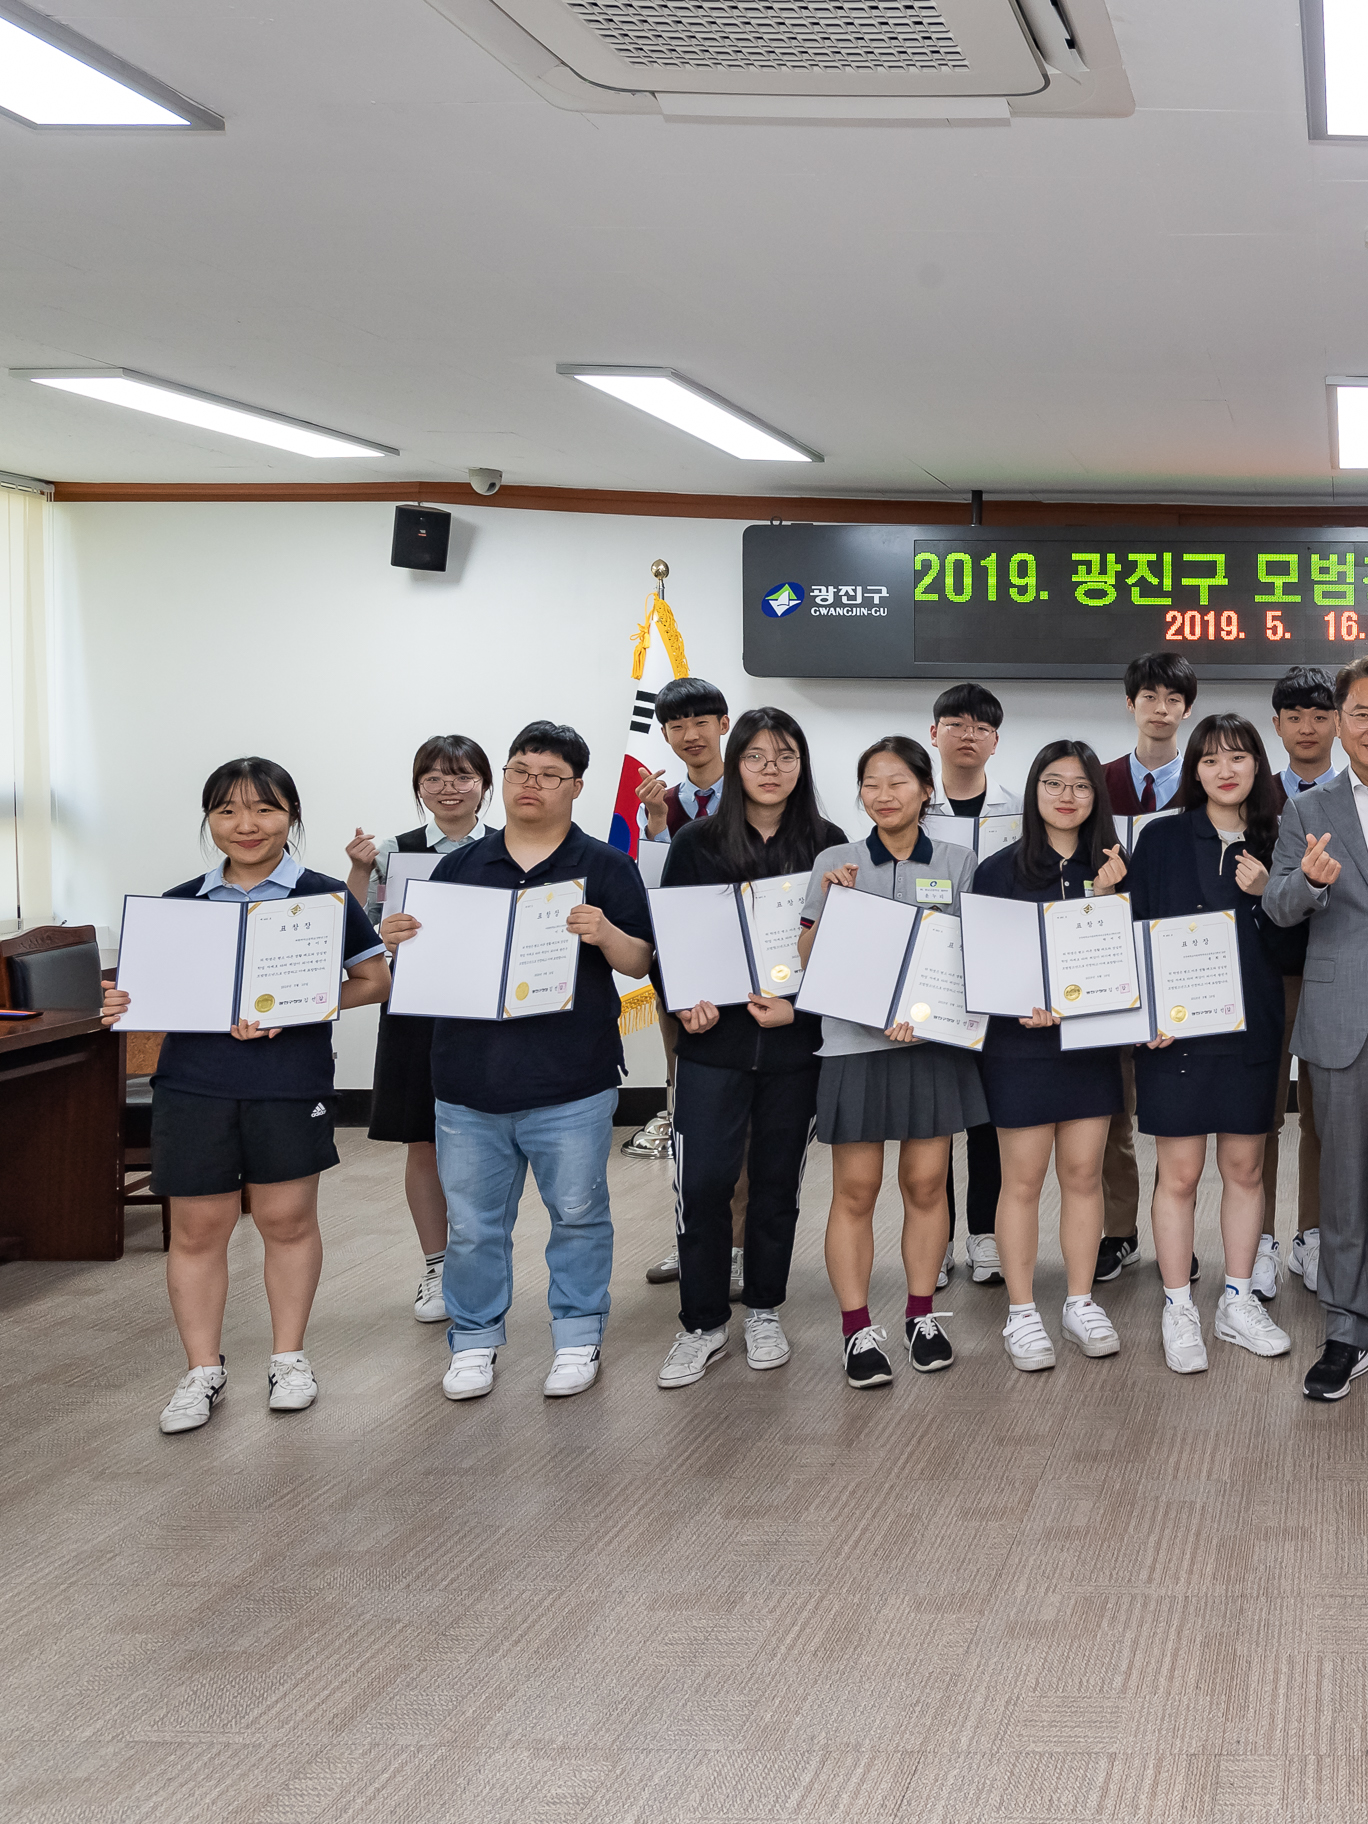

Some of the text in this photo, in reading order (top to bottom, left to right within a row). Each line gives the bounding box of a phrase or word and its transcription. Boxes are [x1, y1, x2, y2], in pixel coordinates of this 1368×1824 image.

[914, 552, 1048, 602] 2019.
[1072, 552, 1229, 607] 광진구
[809, 586, 889, 605] 광진구
[810, 606, 888, 616] GWANGJIN-GU
[1166, 611, 1246, 641] 2019.
[1266, 611, 1291, 641] 5.
